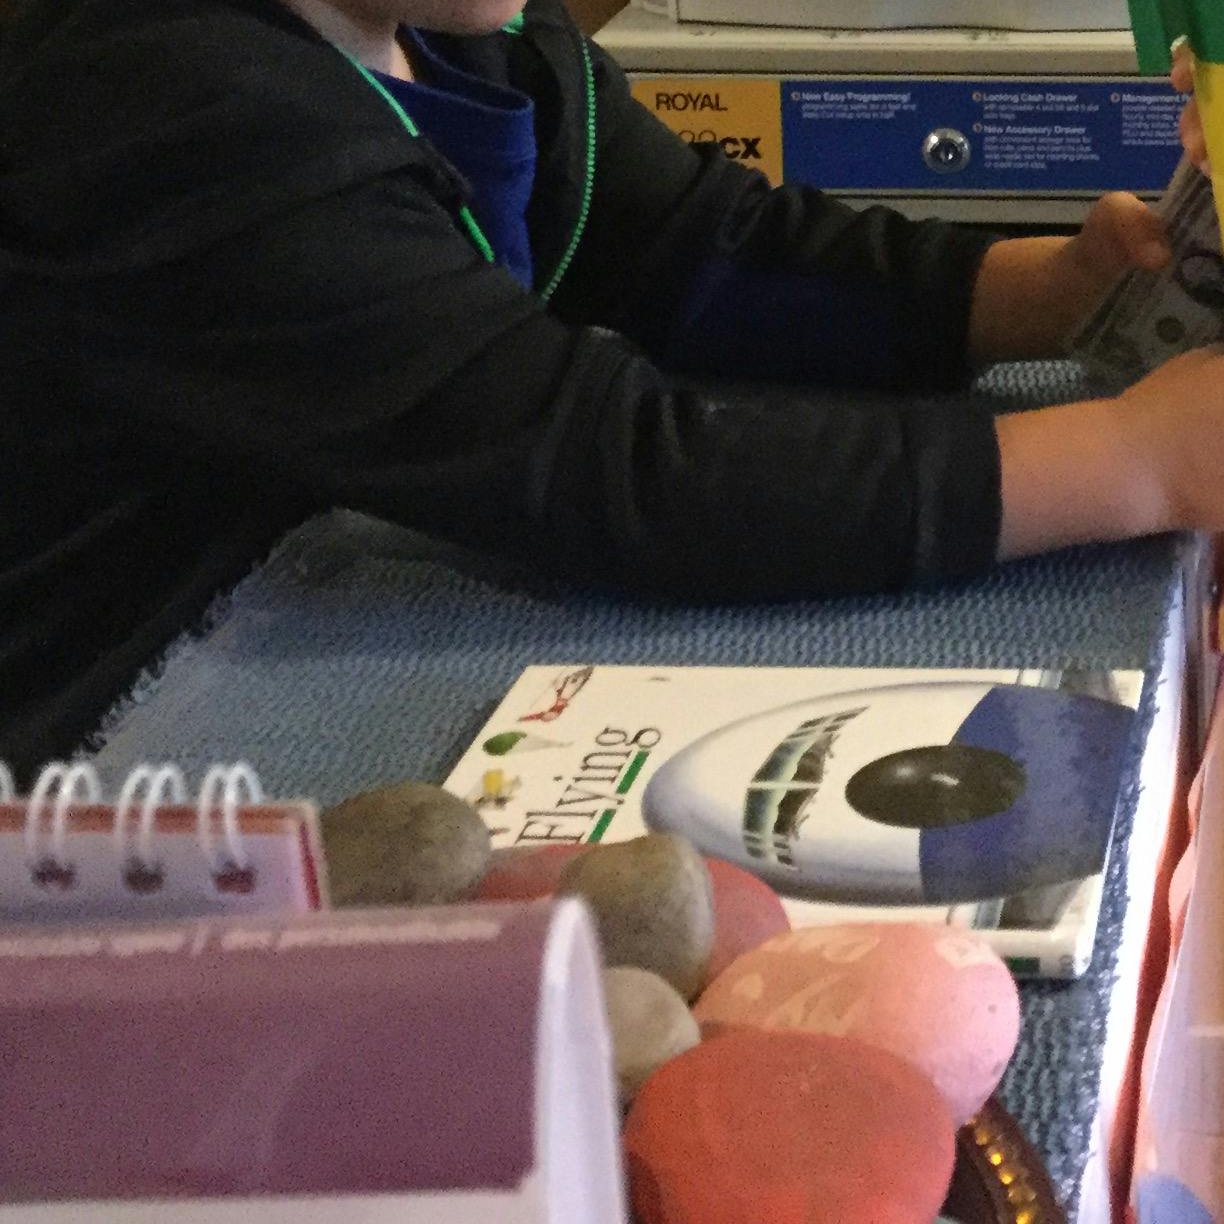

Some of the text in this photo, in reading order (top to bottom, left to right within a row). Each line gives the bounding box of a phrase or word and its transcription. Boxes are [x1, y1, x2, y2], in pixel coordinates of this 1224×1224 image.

[655, 92, 728, 112] ROYAL
[802, 92, 821, 101] New
[823, 92, 845, 102] Easy
[984, 93, 1078, 103] Locking Cash Drawer
[984, 125, 1086, 136] New Accessory Drawer
[515, 727, 662, 844] Flying
